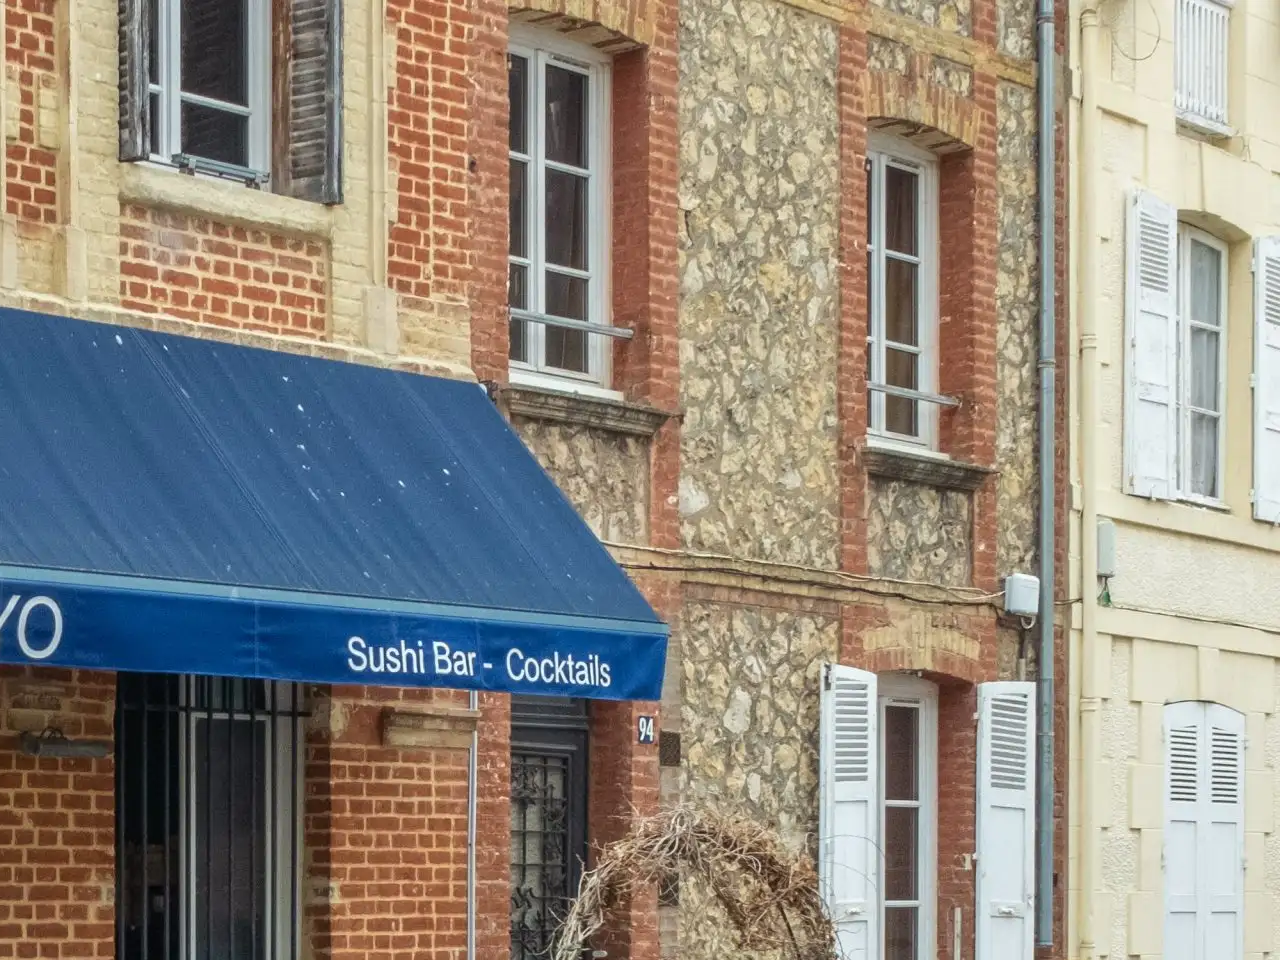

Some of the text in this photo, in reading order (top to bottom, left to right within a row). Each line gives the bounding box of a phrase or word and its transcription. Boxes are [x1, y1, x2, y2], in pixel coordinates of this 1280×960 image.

[347, 636, 425, 674] Sushi
[432, 641, 477, 676] Bar
[506, 648, 612, 687] Cocktails
[639, 717, 653, 742] 94
